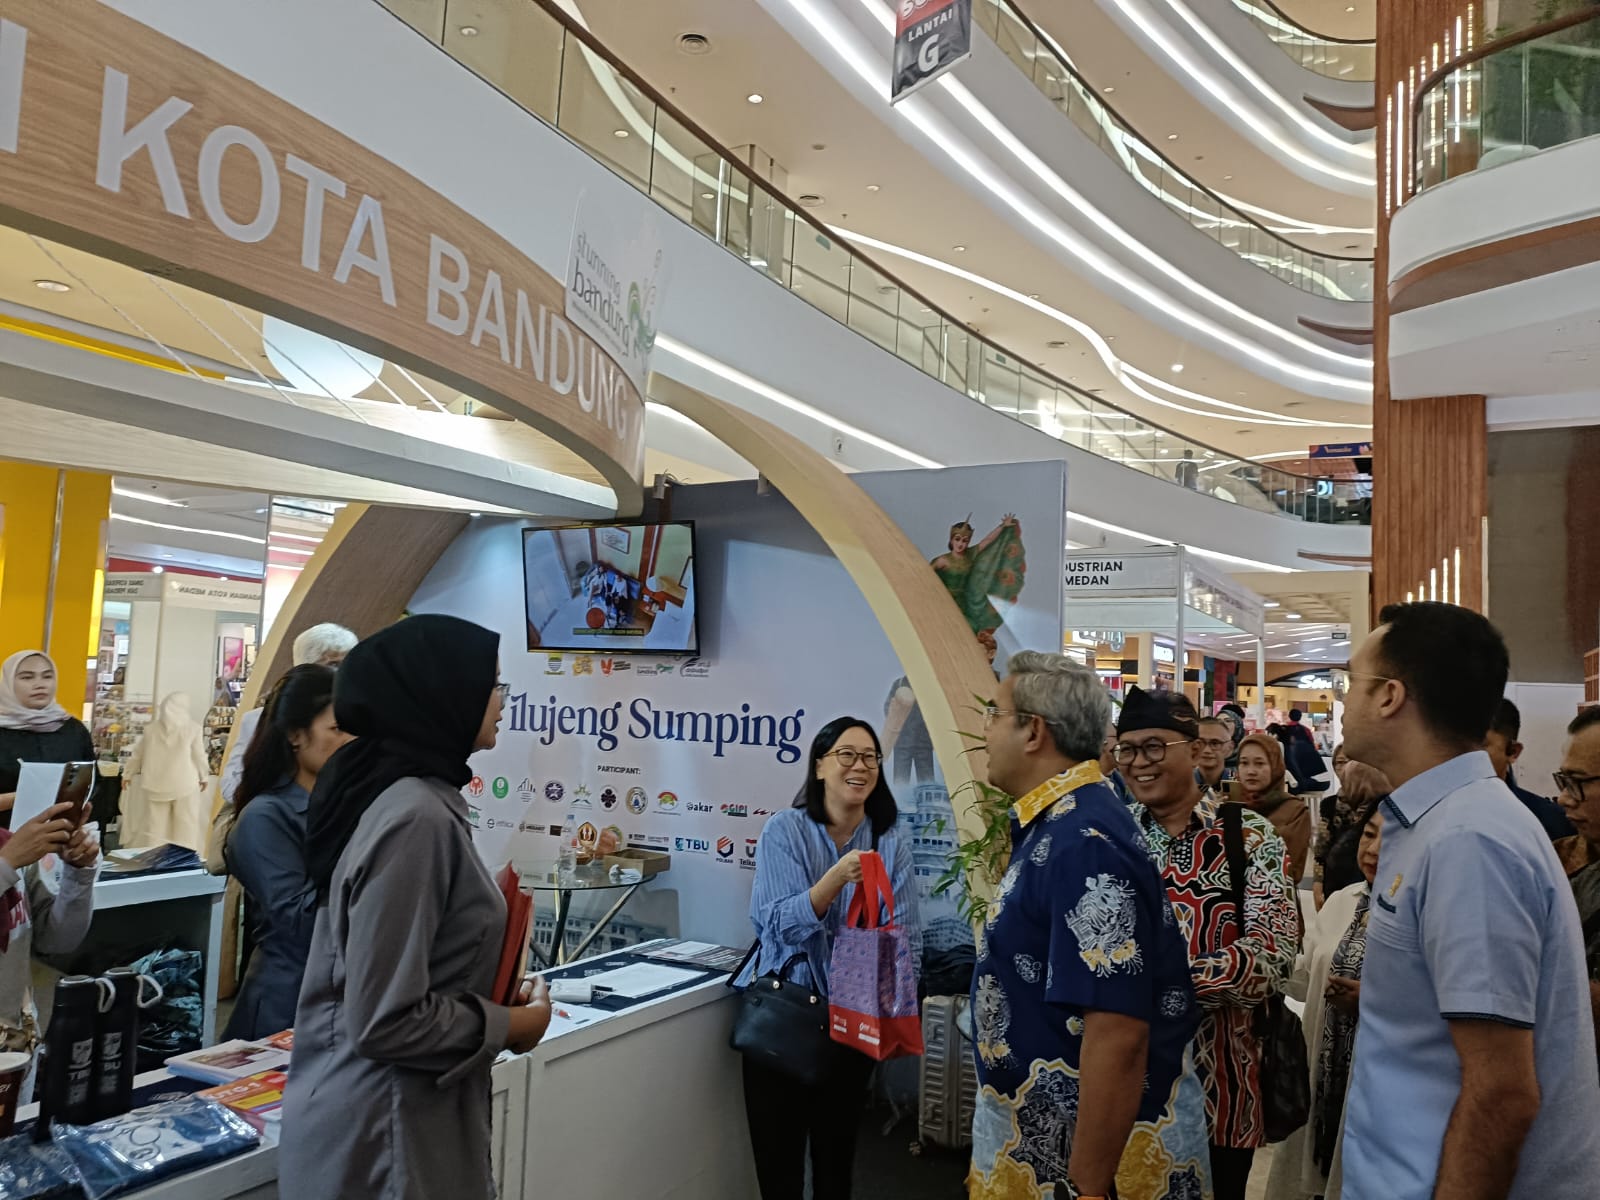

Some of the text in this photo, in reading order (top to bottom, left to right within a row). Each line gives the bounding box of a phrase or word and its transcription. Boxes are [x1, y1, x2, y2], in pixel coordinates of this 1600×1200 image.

[908, 8, 953, 42] LANTAI
[918, 34, 939, 72] G
[95, 65, 397, 307] KOTA
[426, 233, 628, 440] BANDUNG
[571, 255, 631, 354] bandung
[1065, 560, 1123, 572] USTRIAN
[1065, 575, 1109, 586] MEDAN
[509, 692, 805, 764] ilujeng Sumping
[597, 765, 641, 775] PARTICIPANT:
[685, 838, 710, 851] TBU
[739, 858, 757, 867] Telko
